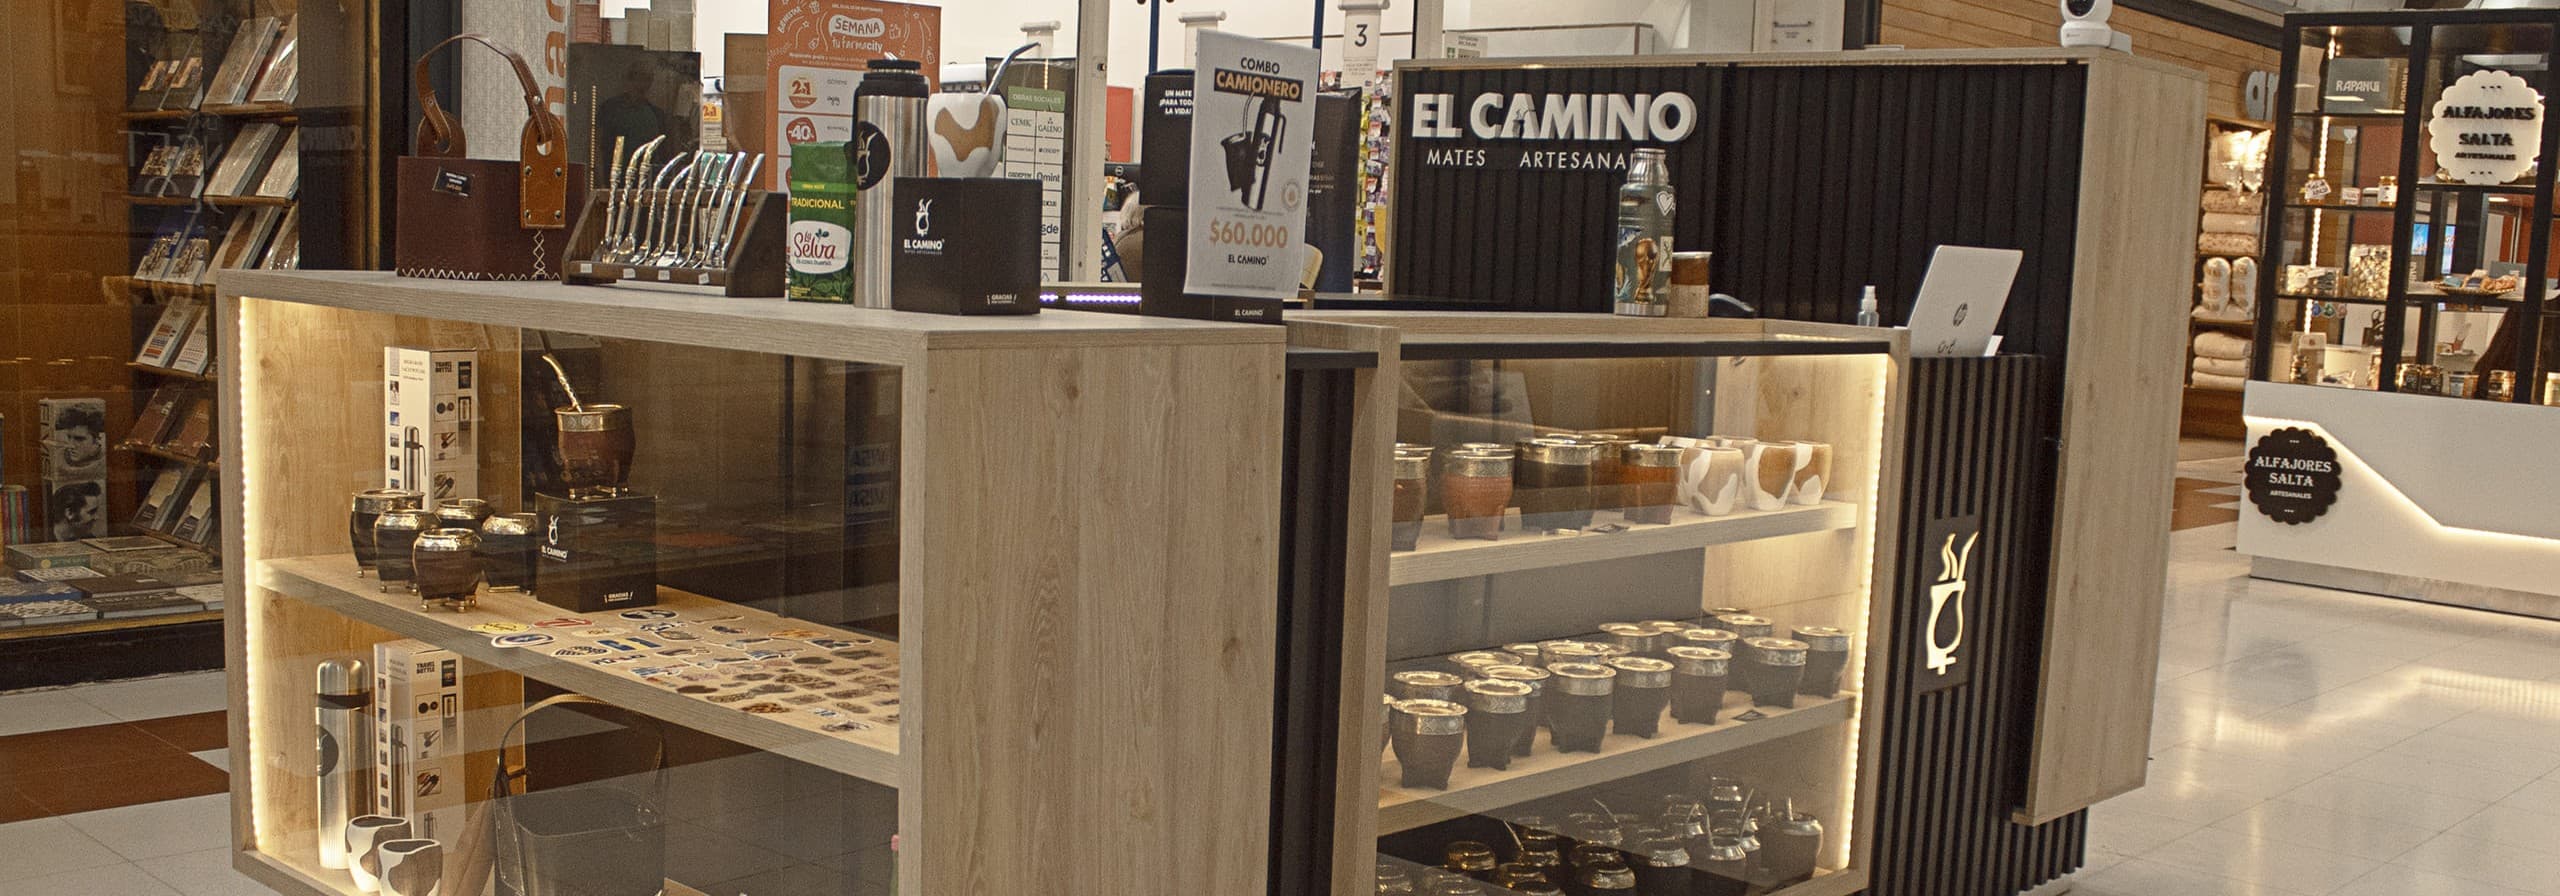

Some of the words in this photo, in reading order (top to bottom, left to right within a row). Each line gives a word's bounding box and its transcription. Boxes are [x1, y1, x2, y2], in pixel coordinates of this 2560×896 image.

[834, 17, 881, 34] SEMANA
[1355, 24, 1368, 47] 3
[841, 36, 883, 53] farmacity
[1241, 57, 1280, 74] COMBO
[1216, 72, 1300, 98] CAMIONERO
[1165, 107, 1173, 115] LA
[1412, 93, 1463, 138] EL
[1470, 91, 1697, 142] CAMINO
[2442, 106, 2536, 120] ALFAJORES
[2459, 133, 2514, 146] SALTA
[1427, 149, 1486, 166] MATES
[2455, 152, 2517, 160] ARTESANALES
[792, 197, 846, 209] TRADICIONAL
[1210, 217, 1288, 249] $60.000
[794, 232, 836, 259] Selva
[904, 239, 911, 249] EL
[912, 239, 943, 250] CAMINO
[1228, 254, 1236, 264] EL
[1237, 254, 1267, 265] CAMINO
[2254, 456, 2332, 473] ALFAJORES
[2268, 472, 2314, 487] SALTA
[2269, 490, 2312, 499] ARTESANALES
